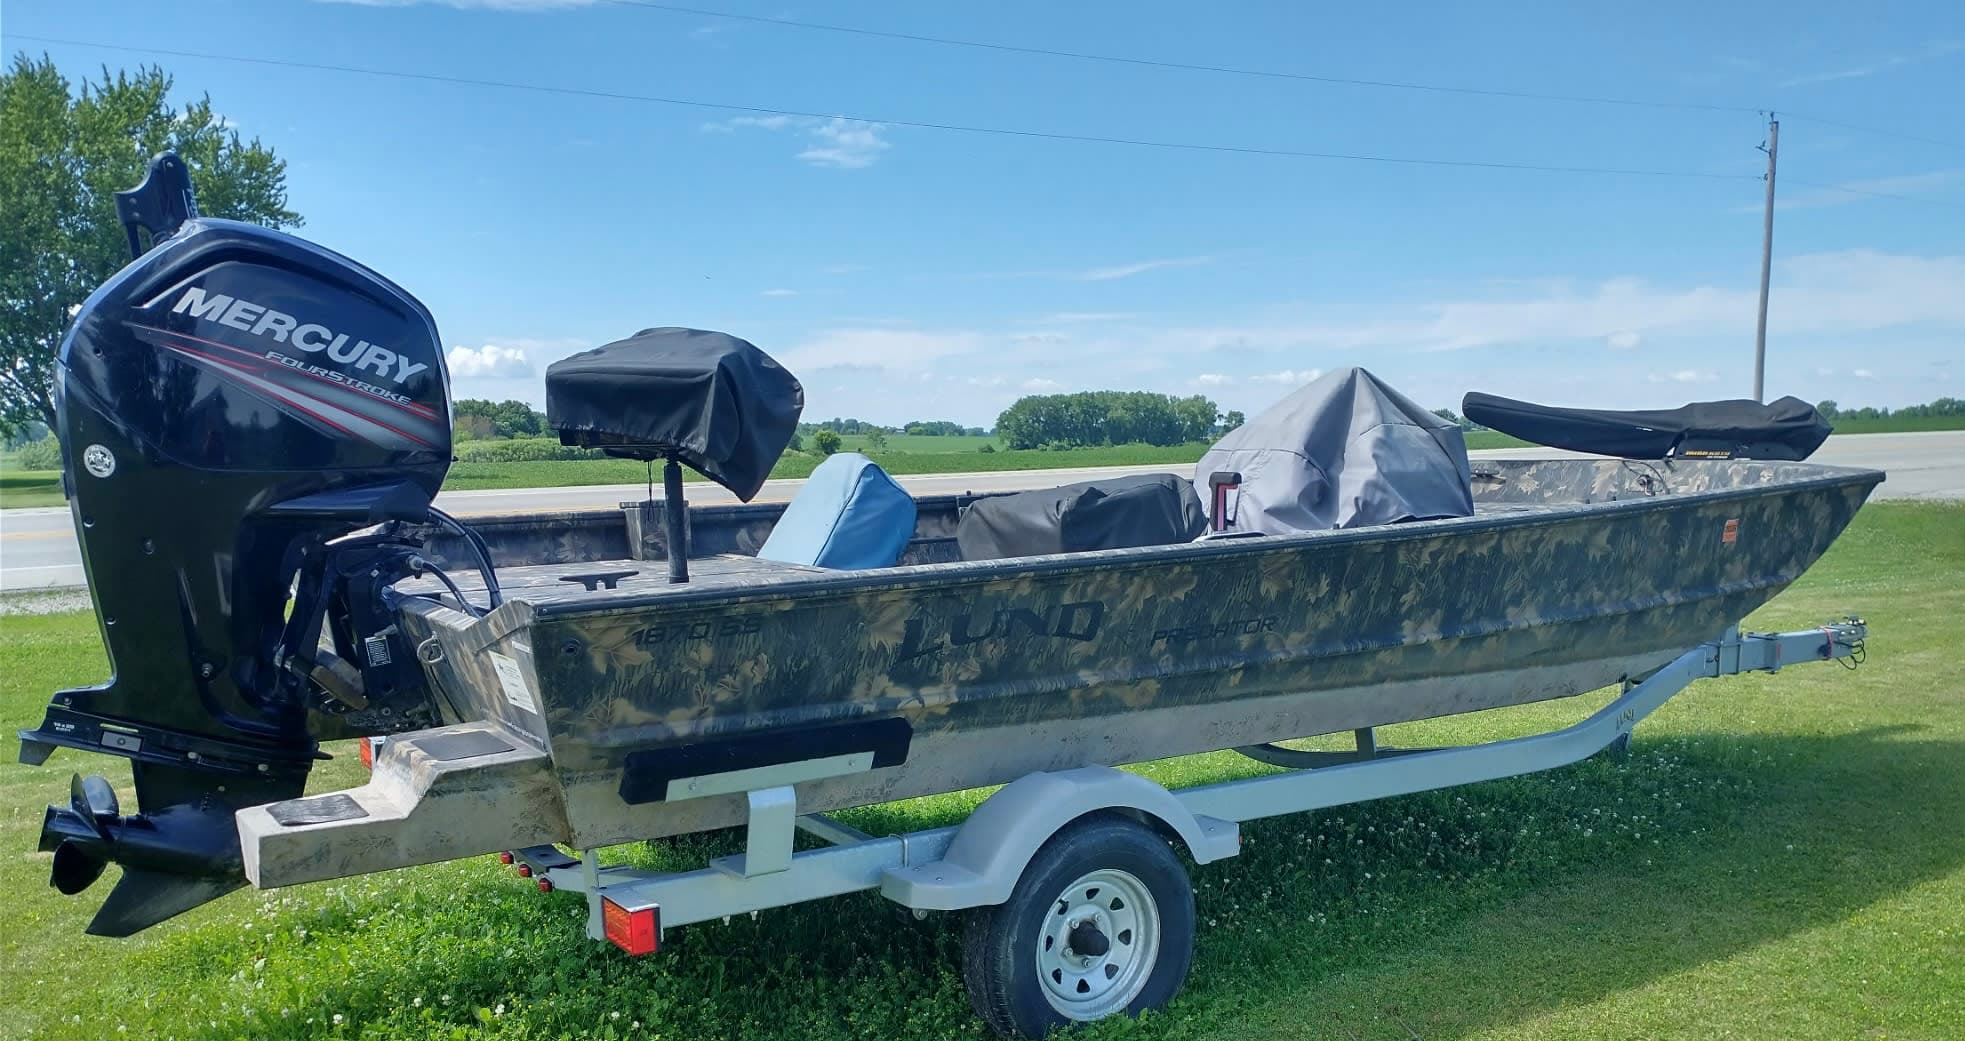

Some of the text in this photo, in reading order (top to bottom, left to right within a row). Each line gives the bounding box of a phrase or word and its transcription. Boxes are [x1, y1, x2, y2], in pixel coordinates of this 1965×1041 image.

[172, 286, 428, 384] MERCURY
[264, 350, 413, 408] FOURSTROKE
[897, 600, 1105, 661] LUND
[1150, 616, 1279, 647] PREDATOR
